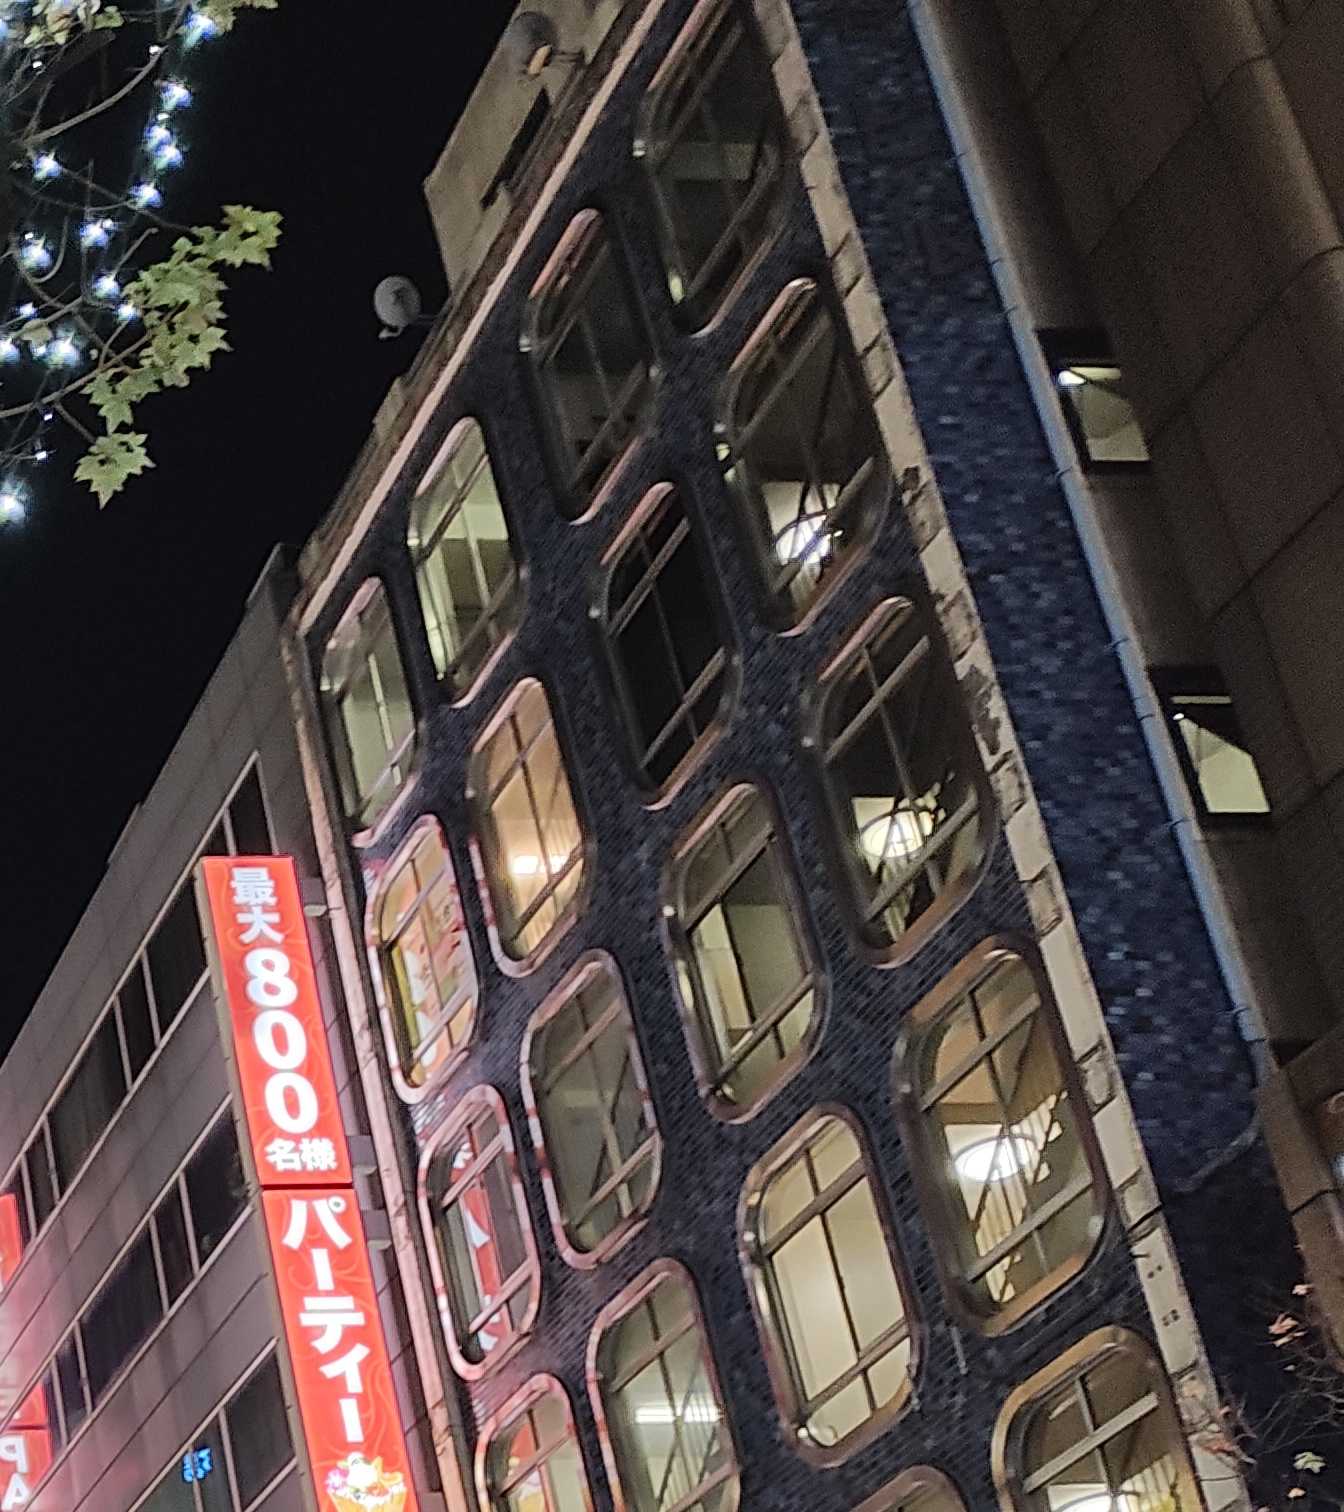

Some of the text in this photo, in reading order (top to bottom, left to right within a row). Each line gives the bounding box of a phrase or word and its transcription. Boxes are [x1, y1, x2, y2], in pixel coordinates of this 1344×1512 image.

[283, 1199, 371, 1443] パーティー
